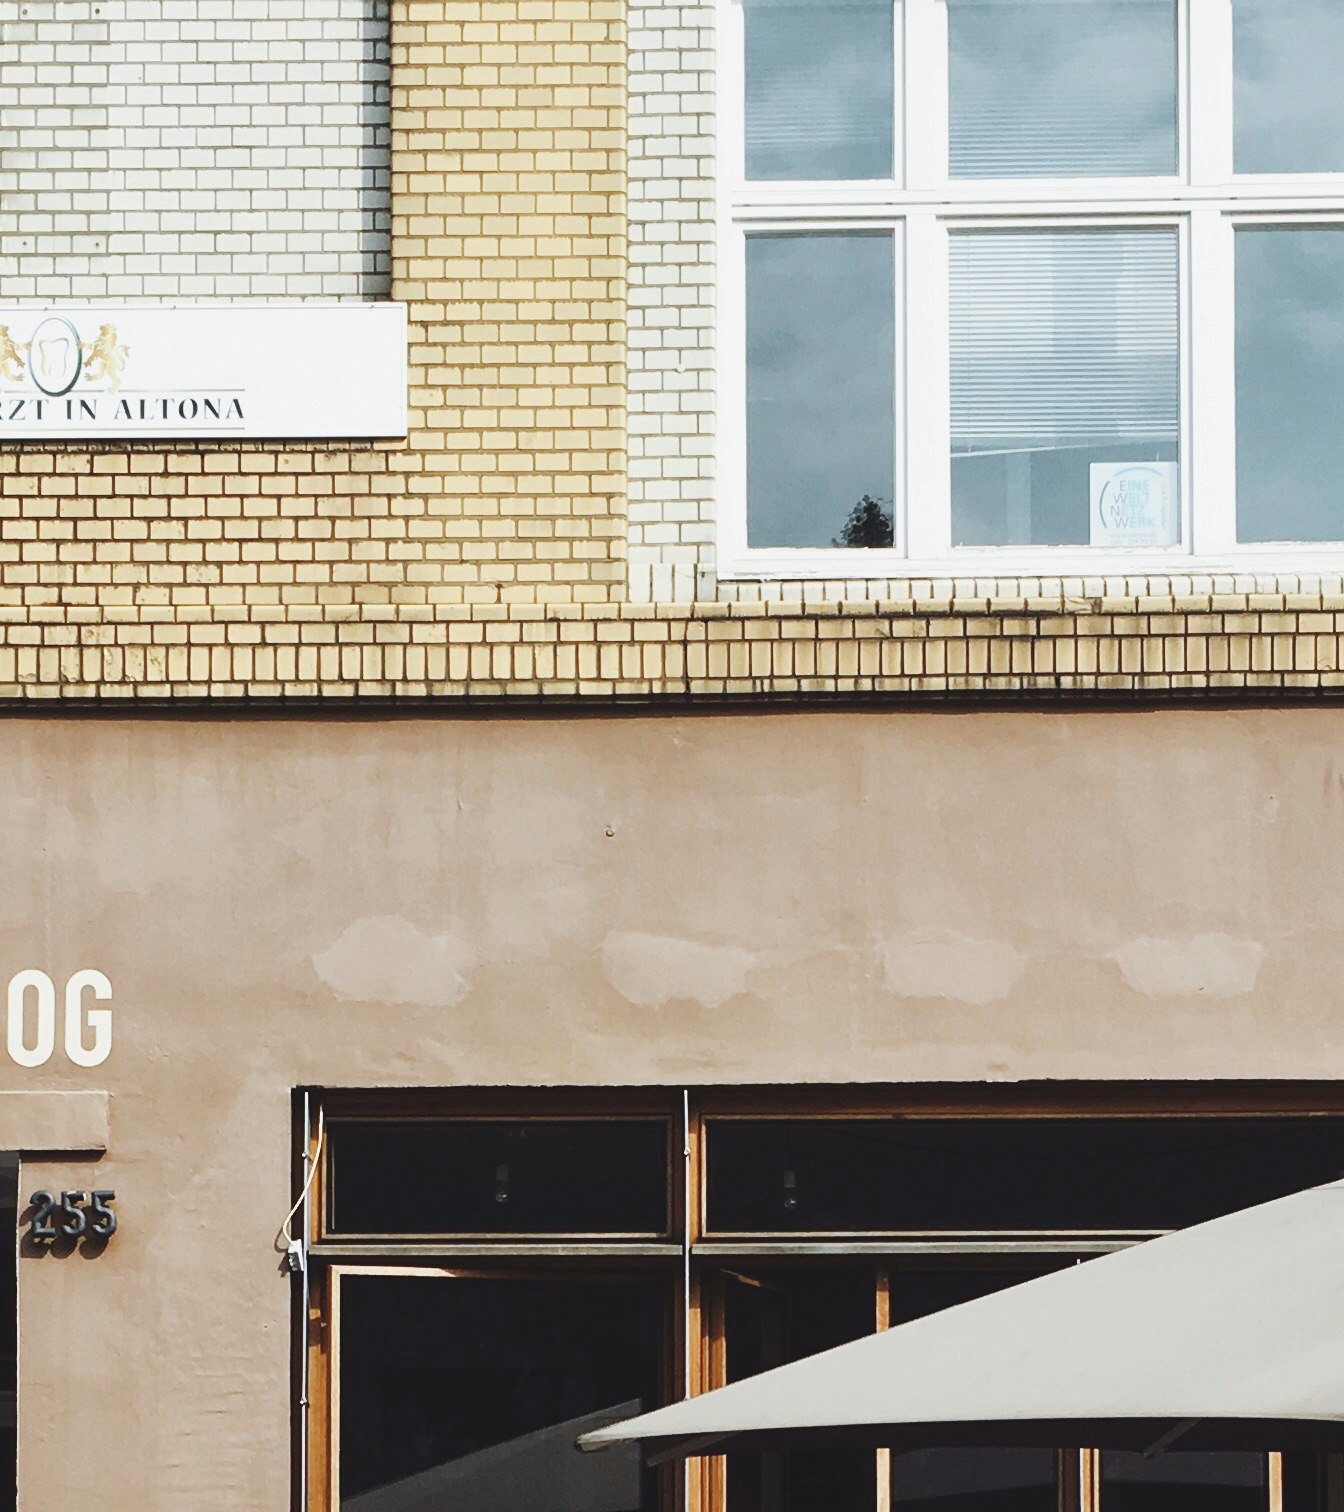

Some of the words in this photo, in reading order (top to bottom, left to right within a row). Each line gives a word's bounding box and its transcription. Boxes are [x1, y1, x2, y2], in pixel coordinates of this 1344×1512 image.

[65, 398, 98, 420] IN
[113, 397, 246, 420] ALTONA
[1119, 479, 1150, 492] EINE
[1113, 492, 1151, 505] WELT
[1114, 517, 1156, 529] WERK
[27, 1188, 117, 1239] 255
